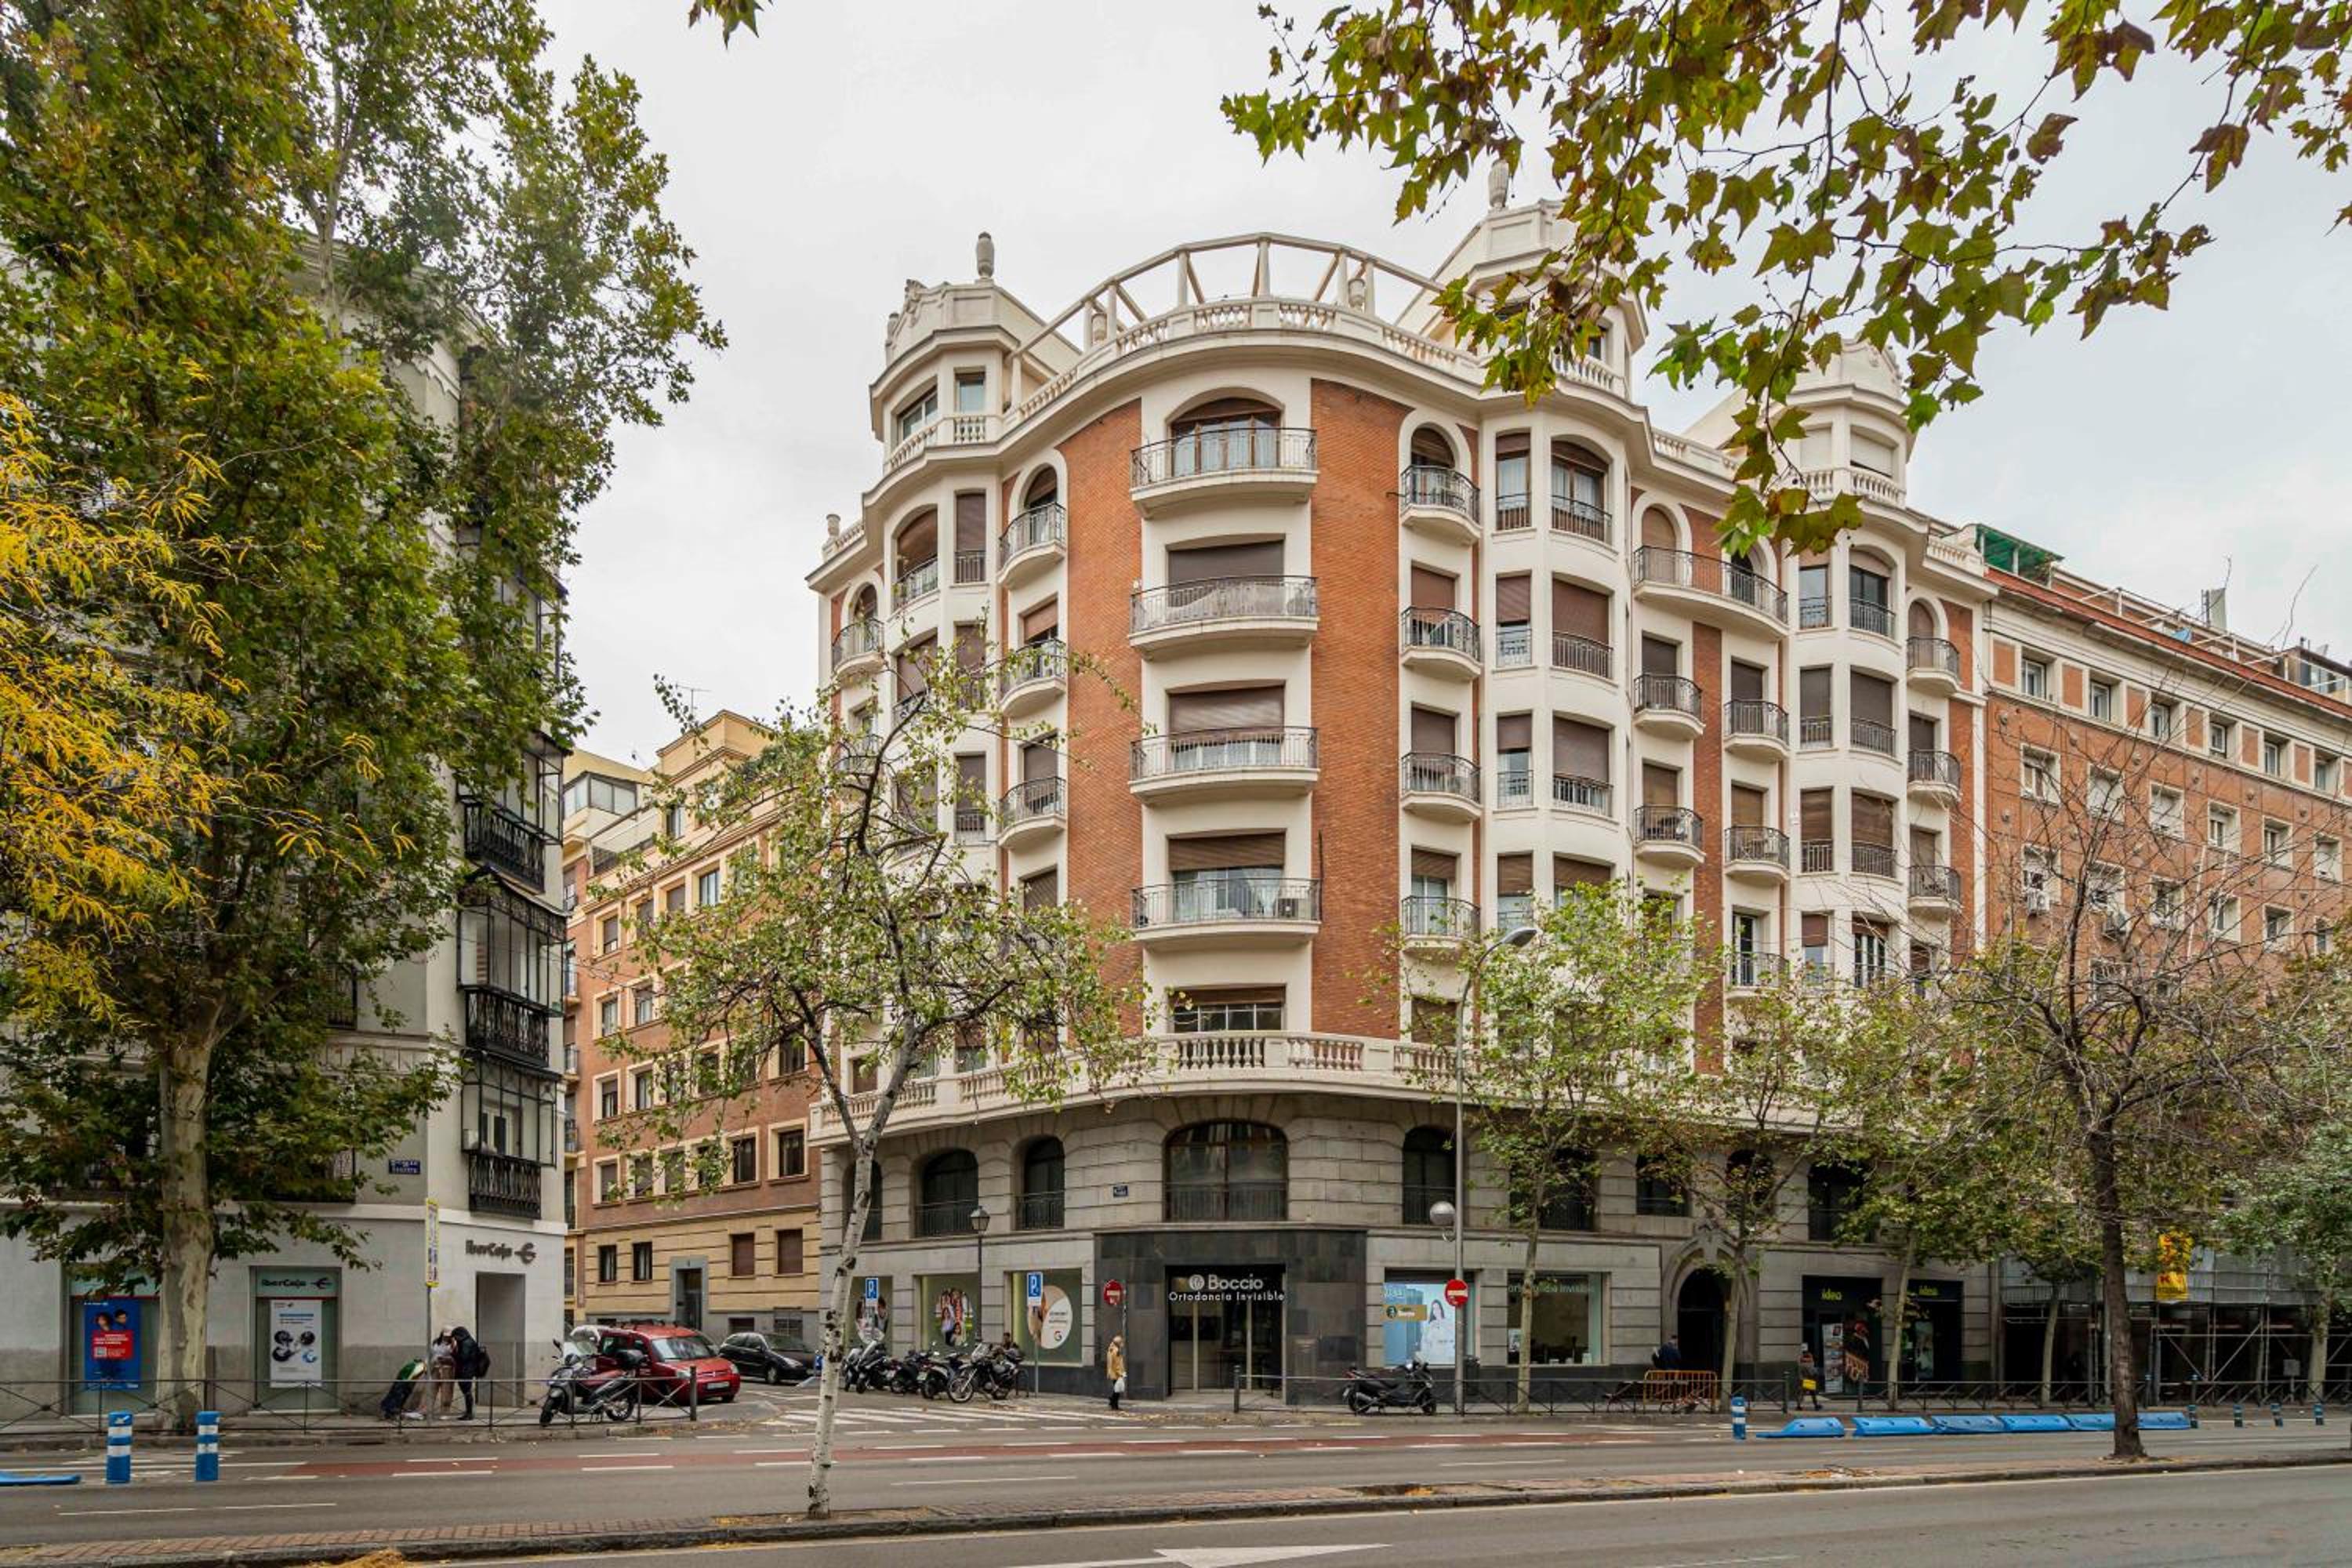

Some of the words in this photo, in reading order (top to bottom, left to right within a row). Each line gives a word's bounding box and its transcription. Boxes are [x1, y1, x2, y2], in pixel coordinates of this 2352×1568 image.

[1208, 1273, 1264, 1290] Boccio
[1169, 1291, 1232, 1301] Ortodoncia
[1236, 1290, 1285, 1301] Invisible
